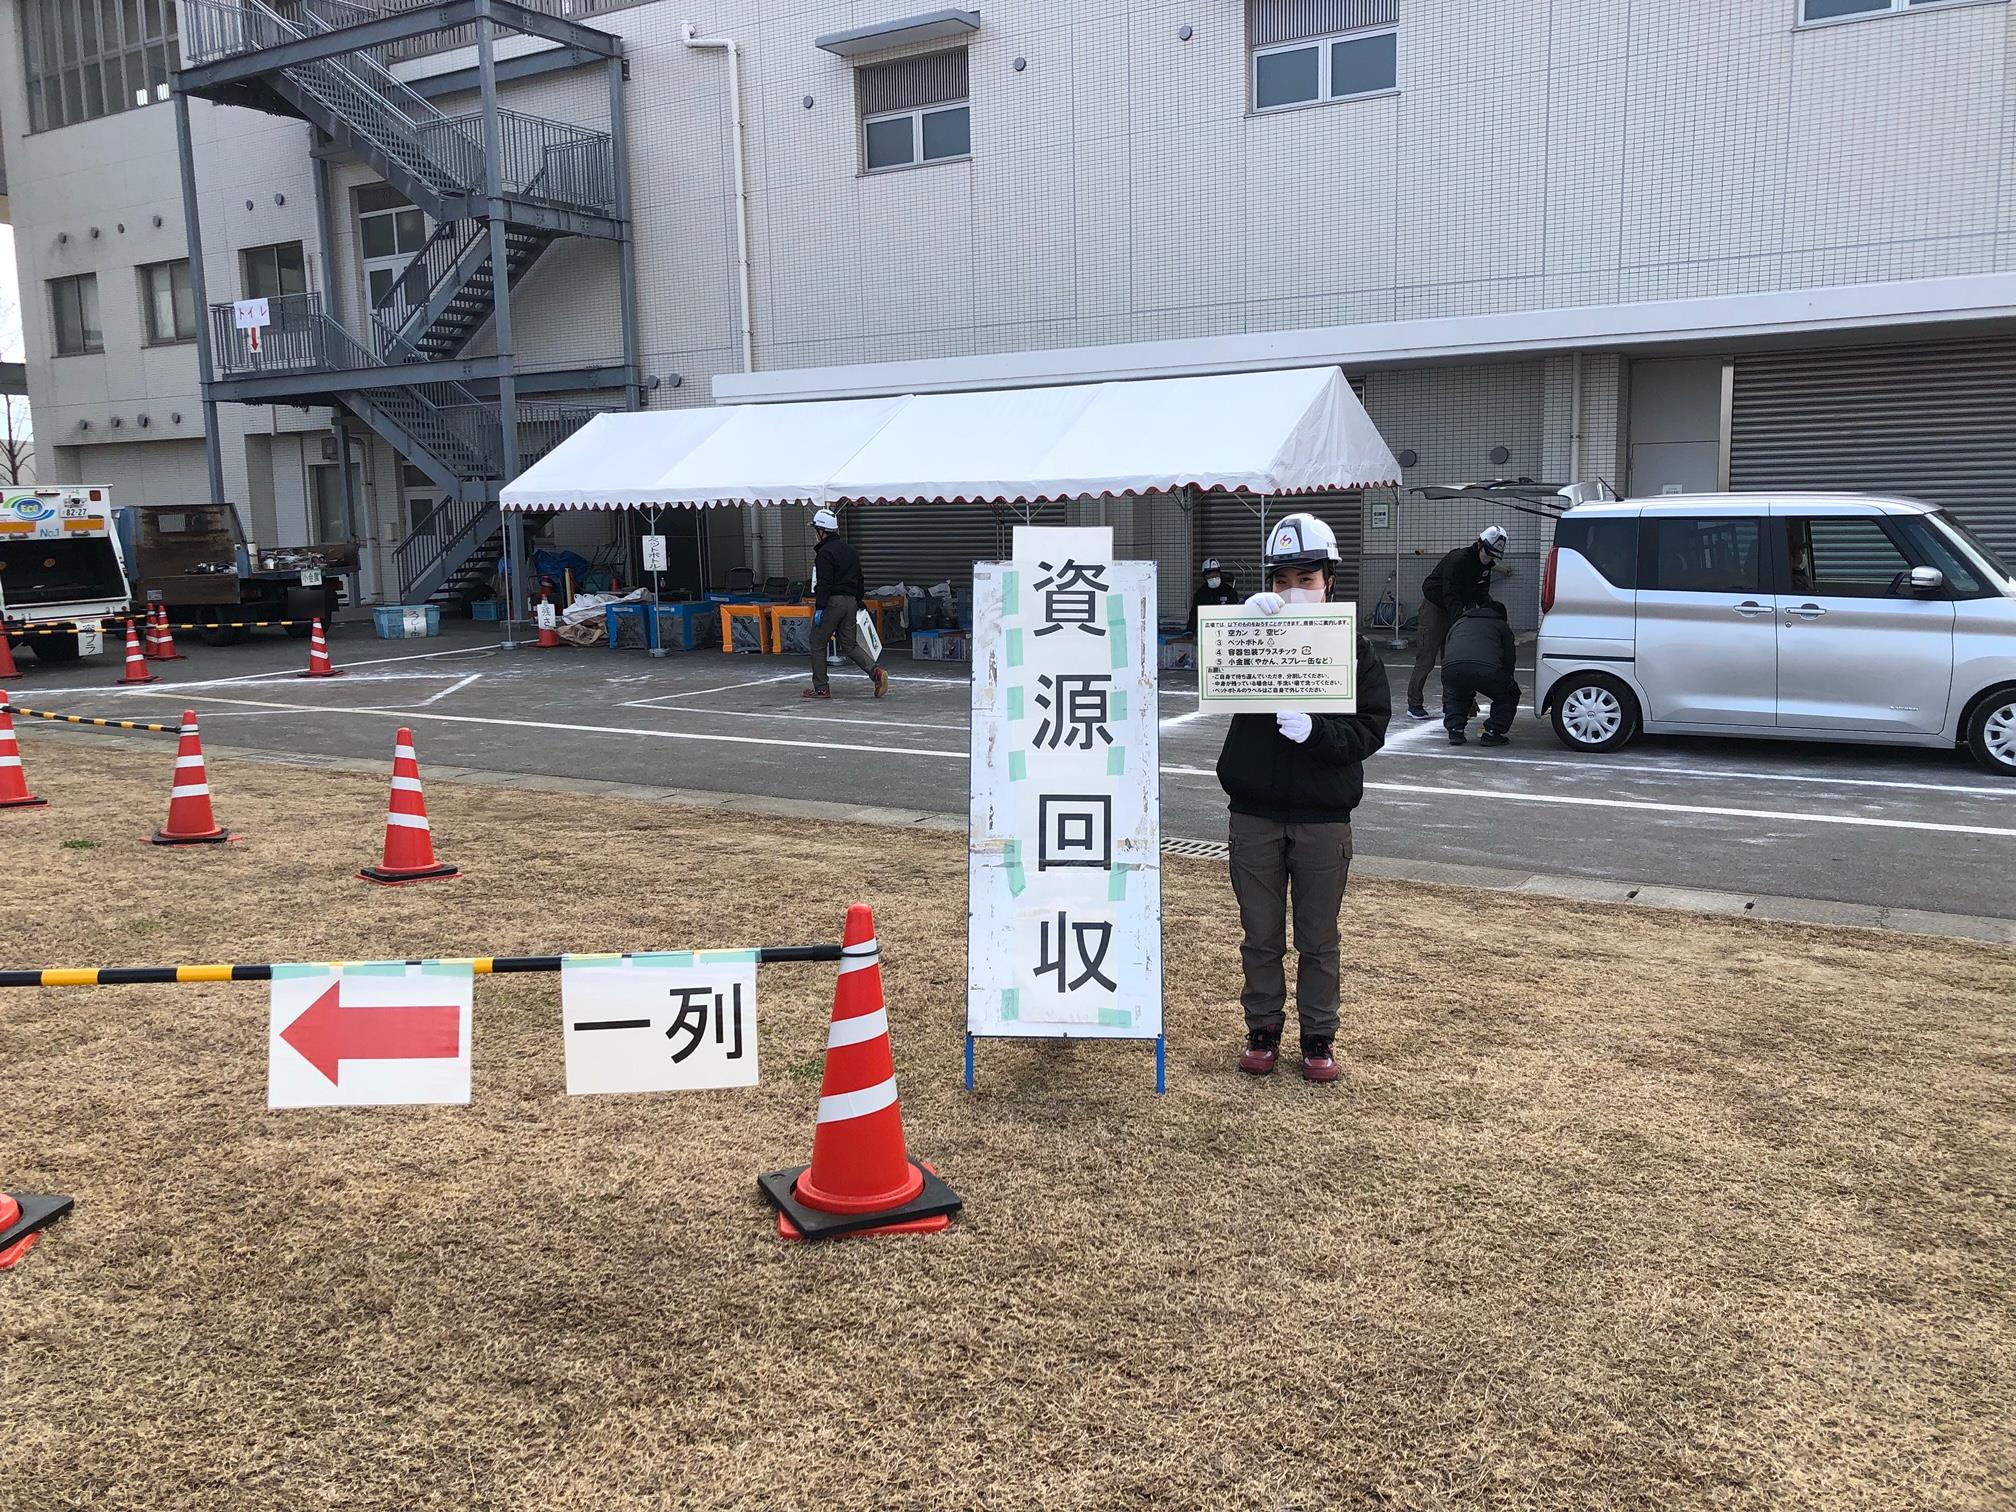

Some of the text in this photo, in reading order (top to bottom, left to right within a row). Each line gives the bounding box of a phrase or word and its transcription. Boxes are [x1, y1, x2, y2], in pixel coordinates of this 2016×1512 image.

[238, 304, 268, 320] トイレ
[648, 537, 661, 569] ペットボトル
[1227, 629, 1248, 637] 空カン
[1266, 628, 1287, 636] 空ビン
[1228, 648, 1297, 656] 容器包装プラスチック
[1032, 558, 1118, 994] 資源回収
[573, 982, 743, 1065] 一列
